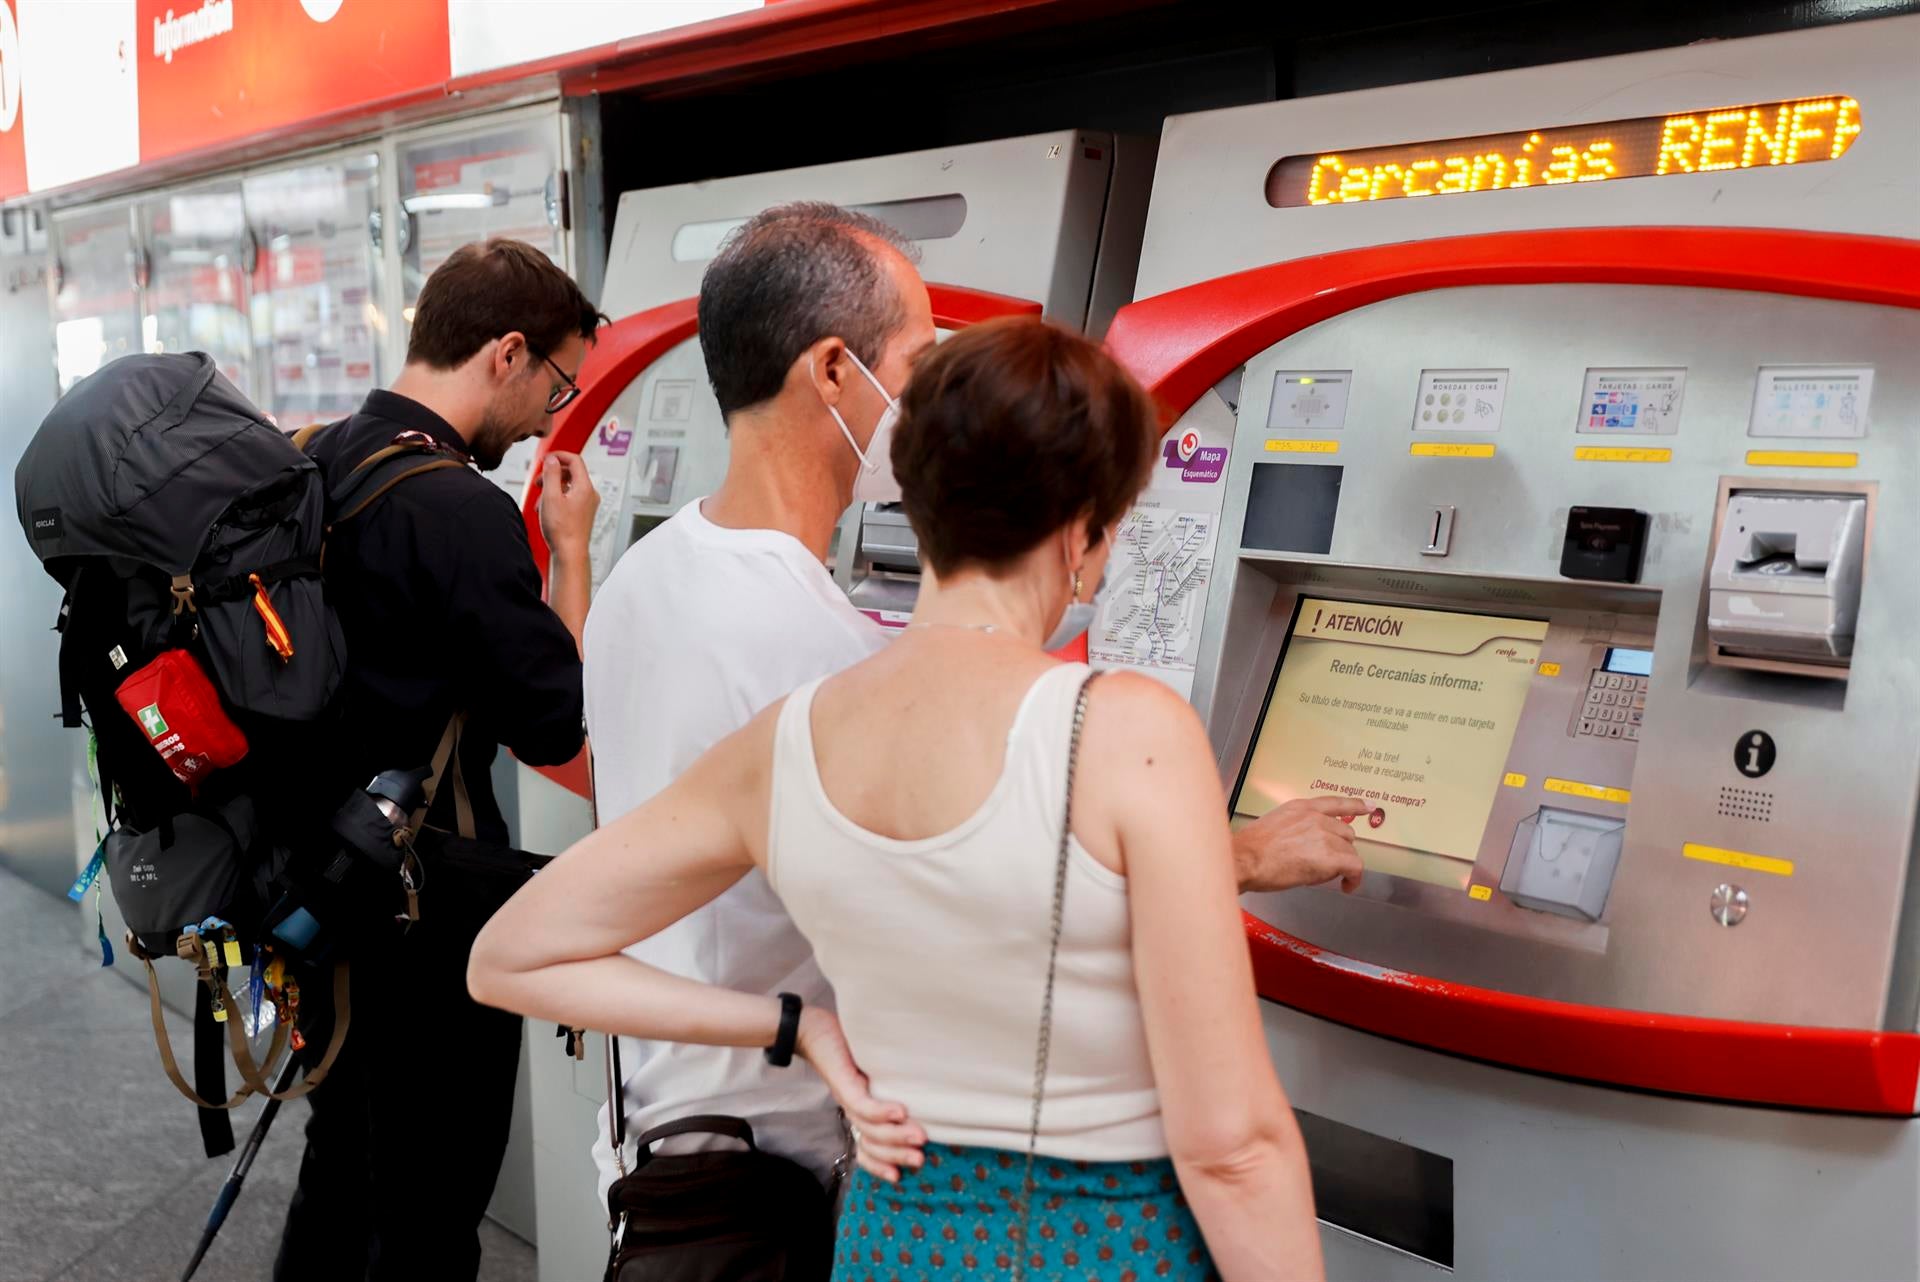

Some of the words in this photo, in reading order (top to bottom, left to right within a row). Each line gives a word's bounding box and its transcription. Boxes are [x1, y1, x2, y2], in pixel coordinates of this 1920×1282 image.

[1307, 131, 1616, 206] Cercanías
[1200, 450, 1221, 463] Mapa
[1183, 469, 1218, 479] Esquemático
[1325, 612, 1404, 637] ATENCIÓN
[1495, 648, 1518, 657] renfe
[1330, 659, 1365, 676] Renfe
[1429, 671, 1484, 692] informa:
[1299, 692, 1310, 703] Su
[1331, 697, 1342, 708] de
[1342, 699, 1382, 714] transporte
[1383, 706, 1393, 715] se
[1394, 707, 1405, 717] va
[1406, 709, 1412, 718] a
[1413, 709, 1436, 721] emitir
[1437, 713, 1448, 723] en
[1450, 715, 1466, 726] una
[1468, 717, 1495, 731] tarjeta
[1366, 716, 1409, 732] reutilizable
[1374, 750, 1382, 761] la
[1323, 756, 1348, 770] Puede
[1350, 761, 1373, 774] volver
[1374, 766, 1380, 775] a
[1310, 779, 1339, 793] ¿Desea
[1339, 785, 1365, 797] seguir
[1365, 789, 1380, 799] con
[1382, 791, 1390, 801] la
[1390, 793, 1426, 809] compra?
